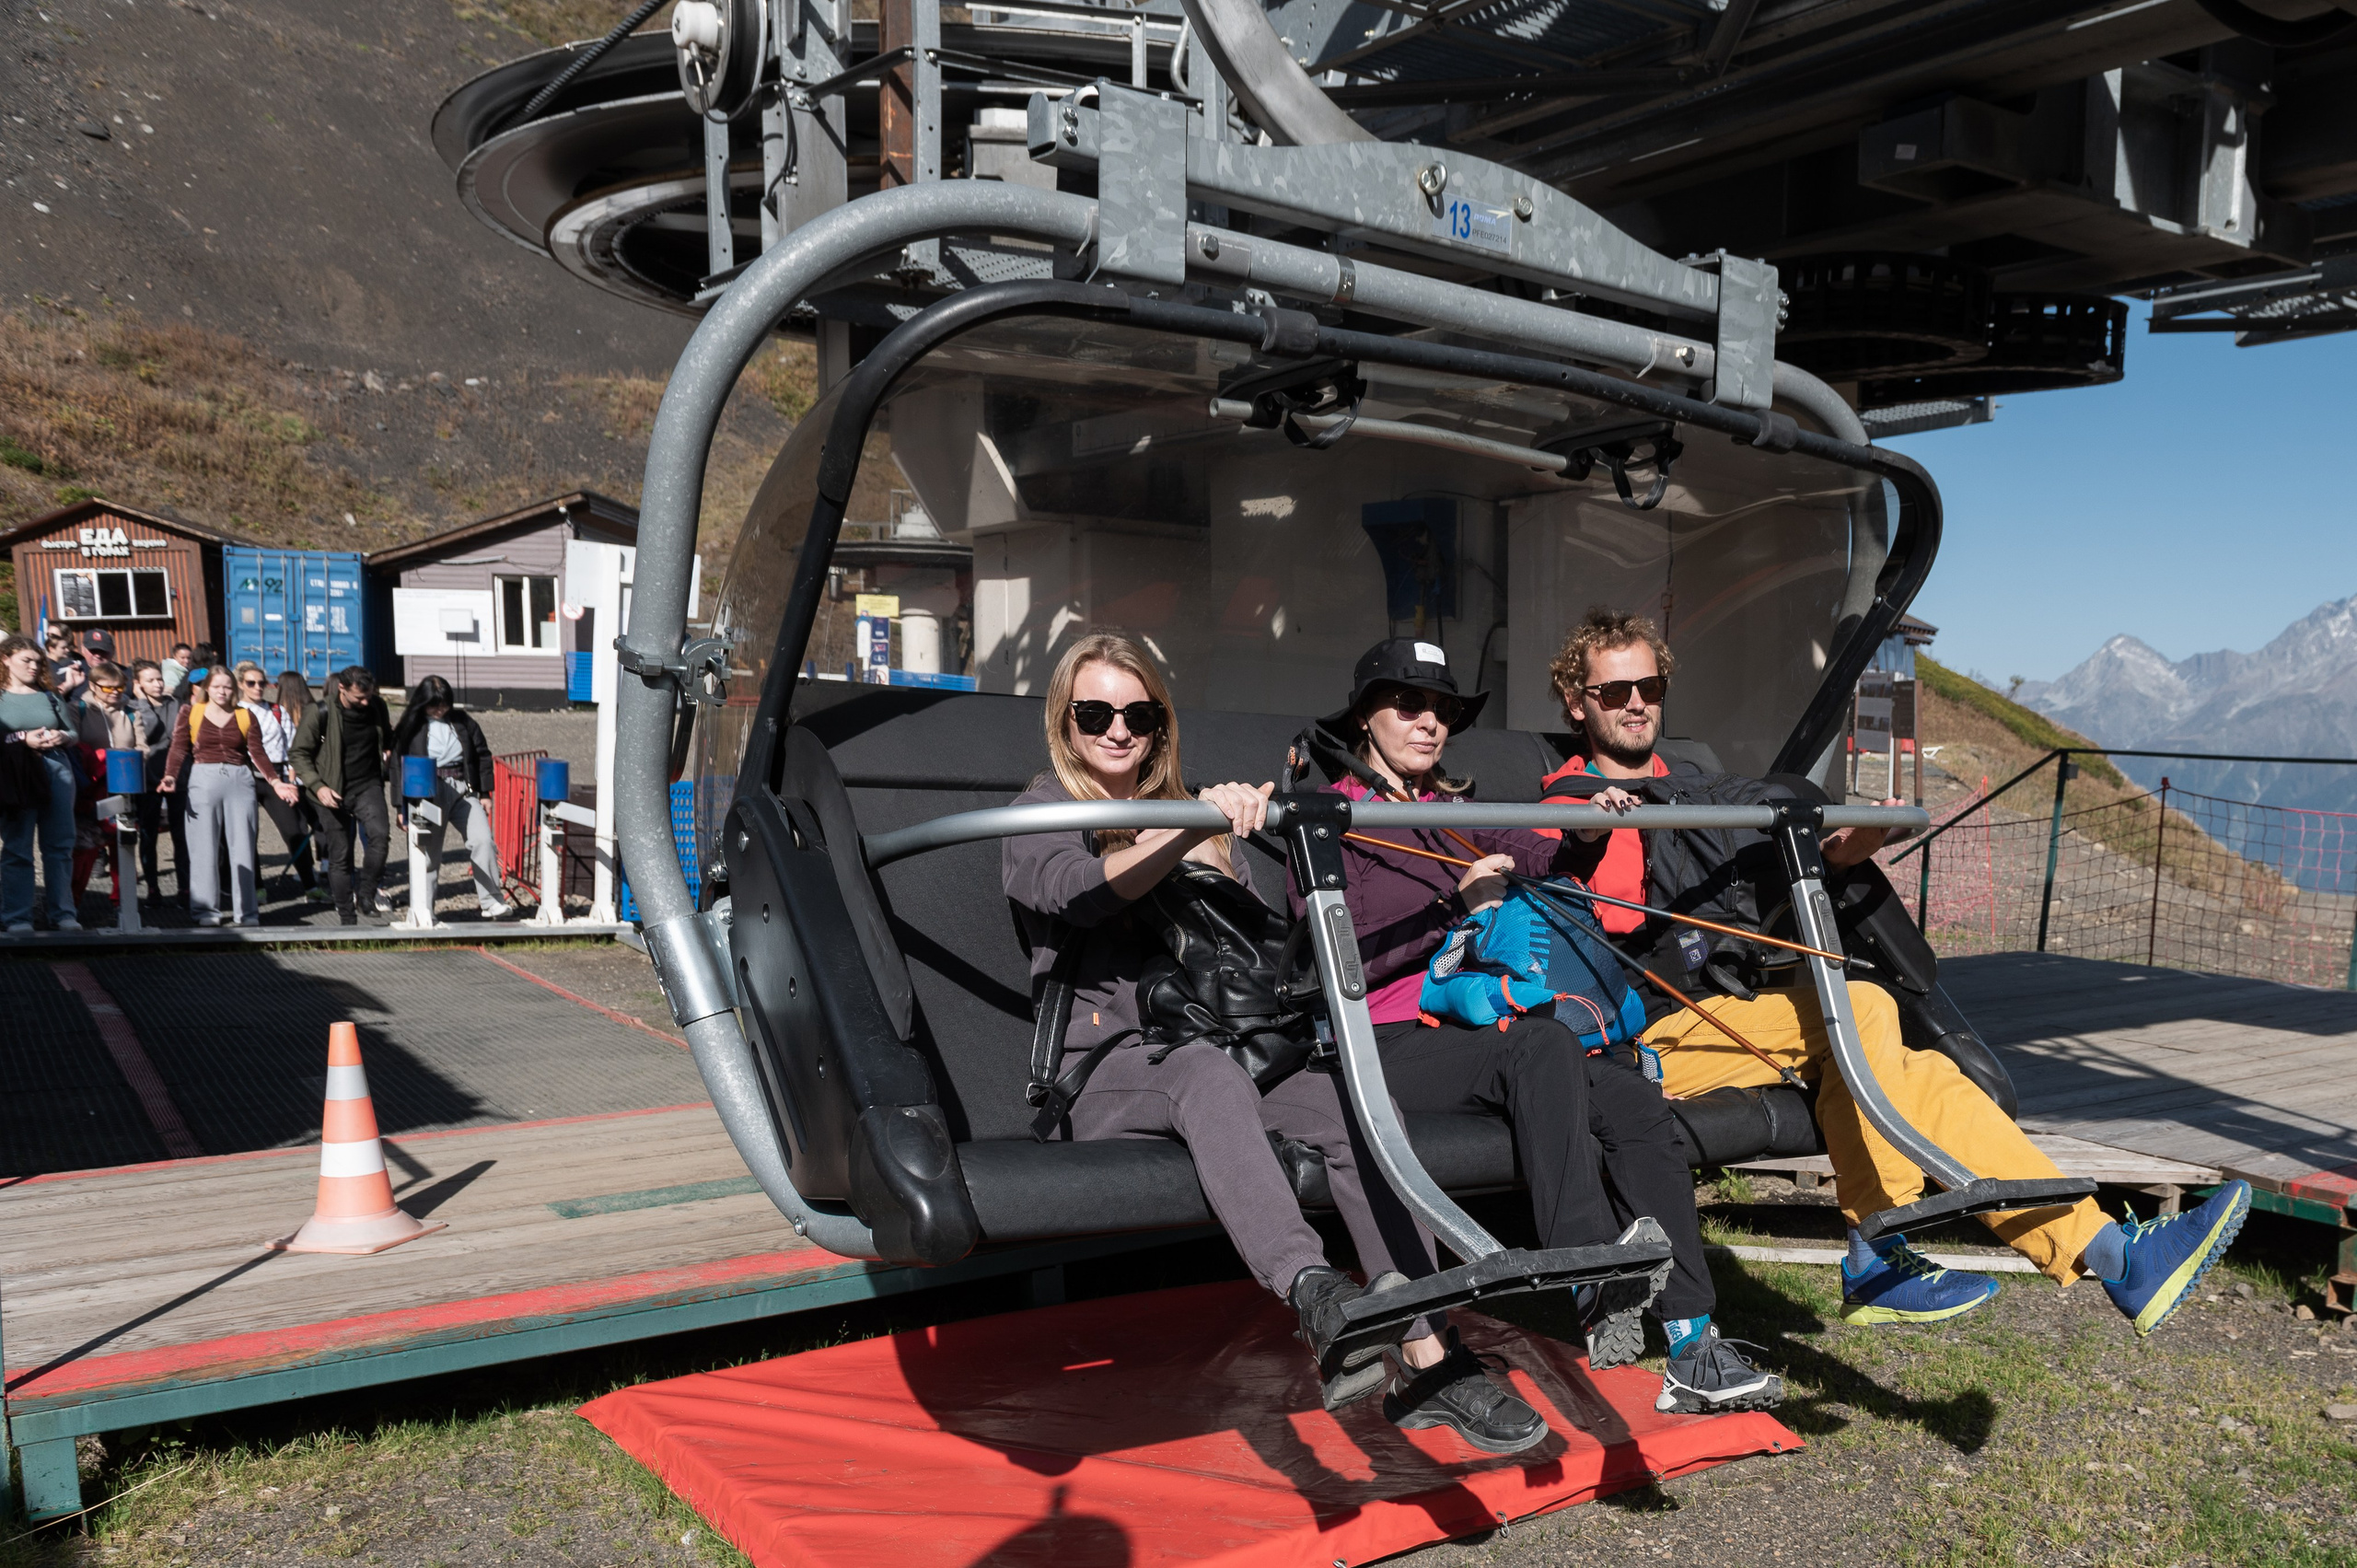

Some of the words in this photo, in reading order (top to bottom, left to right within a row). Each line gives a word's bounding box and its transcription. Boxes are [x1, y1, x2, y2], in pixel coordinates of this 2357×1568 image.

[1449, 201, 1470, 238] 13
[79, 527, 129, 547] ЕДА
[264, 577, 284, 593] 92
